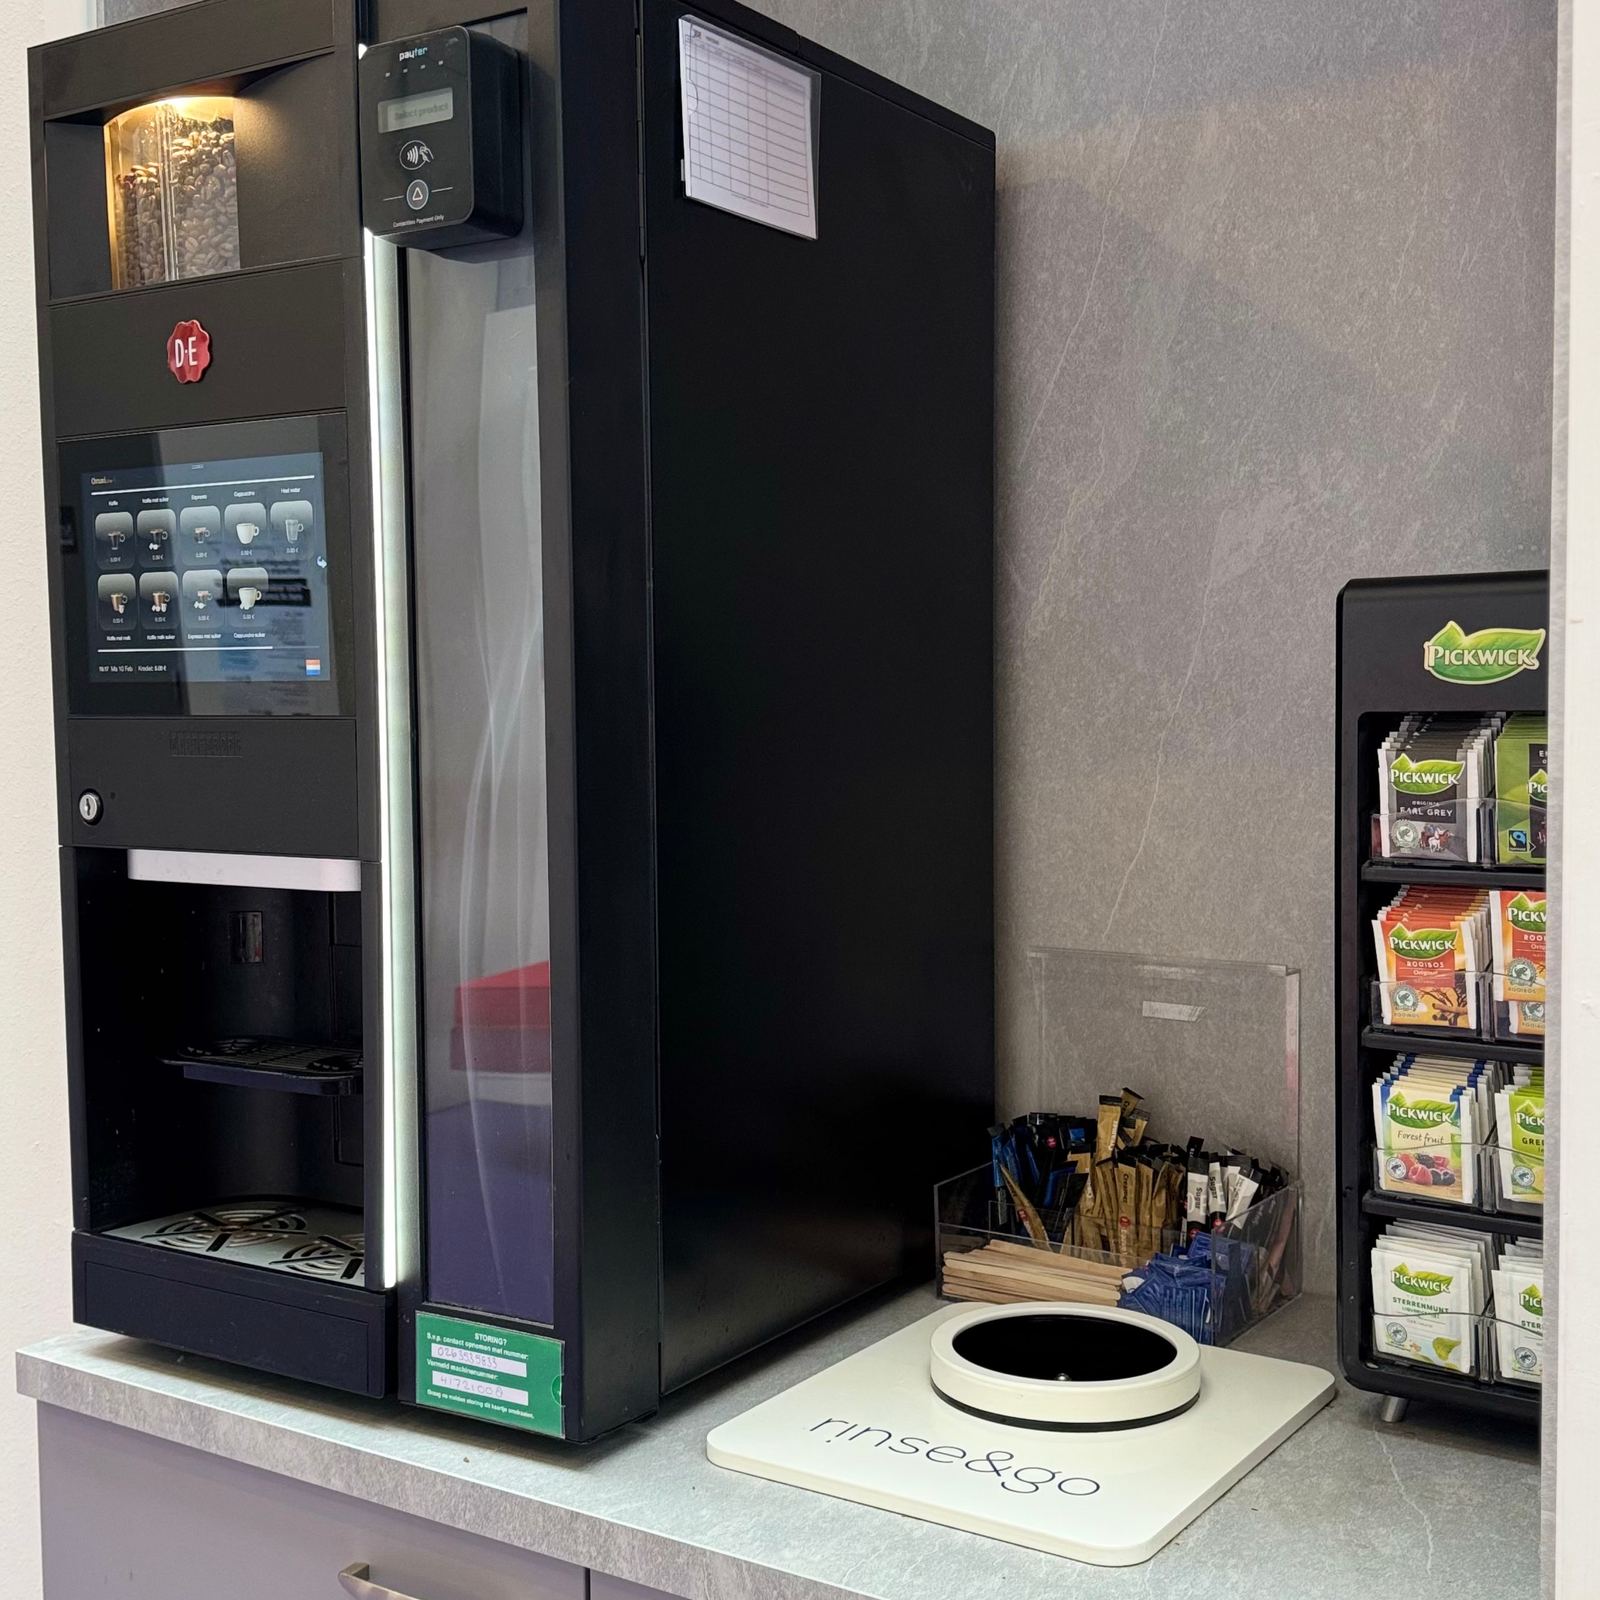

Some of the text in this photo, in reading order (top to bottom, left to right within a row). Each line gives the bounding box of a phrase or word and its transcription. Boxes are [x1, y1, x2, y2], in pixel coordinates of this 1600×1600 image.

[399, 47, 428, 61] payter
[1427, 644, 1537, 668] PICKWICK
[1390, 768, 1459, 786] PICKWICK
[1399, 806, 1454, 817] EARL GREY
[1389, 936, 1456, 951] PICKWICK
[1406, 961, 1445, 969] ROOIBOS
[1387, 1102, 1452, 1123] PICKWICK
[1397, 1130, 1445, 1147] Forest fruit
[1208, 1176, 1218, 1200] Sugar
[1195, 1187, 1203, 1210] Sugar
[1391, 1271, 1450, 1293] PICKWICK
[1392, 1296, 1449, 1314] STERRENMUNT
[443, 1336, 465, 1347] contact
[464, 1341, 492, 1352] opnemen
[491, 1346, 503, 1355] met
[474, 1332, 508, 1347] STORING?
[808, 1417, 1101, 1497] rinse&go
